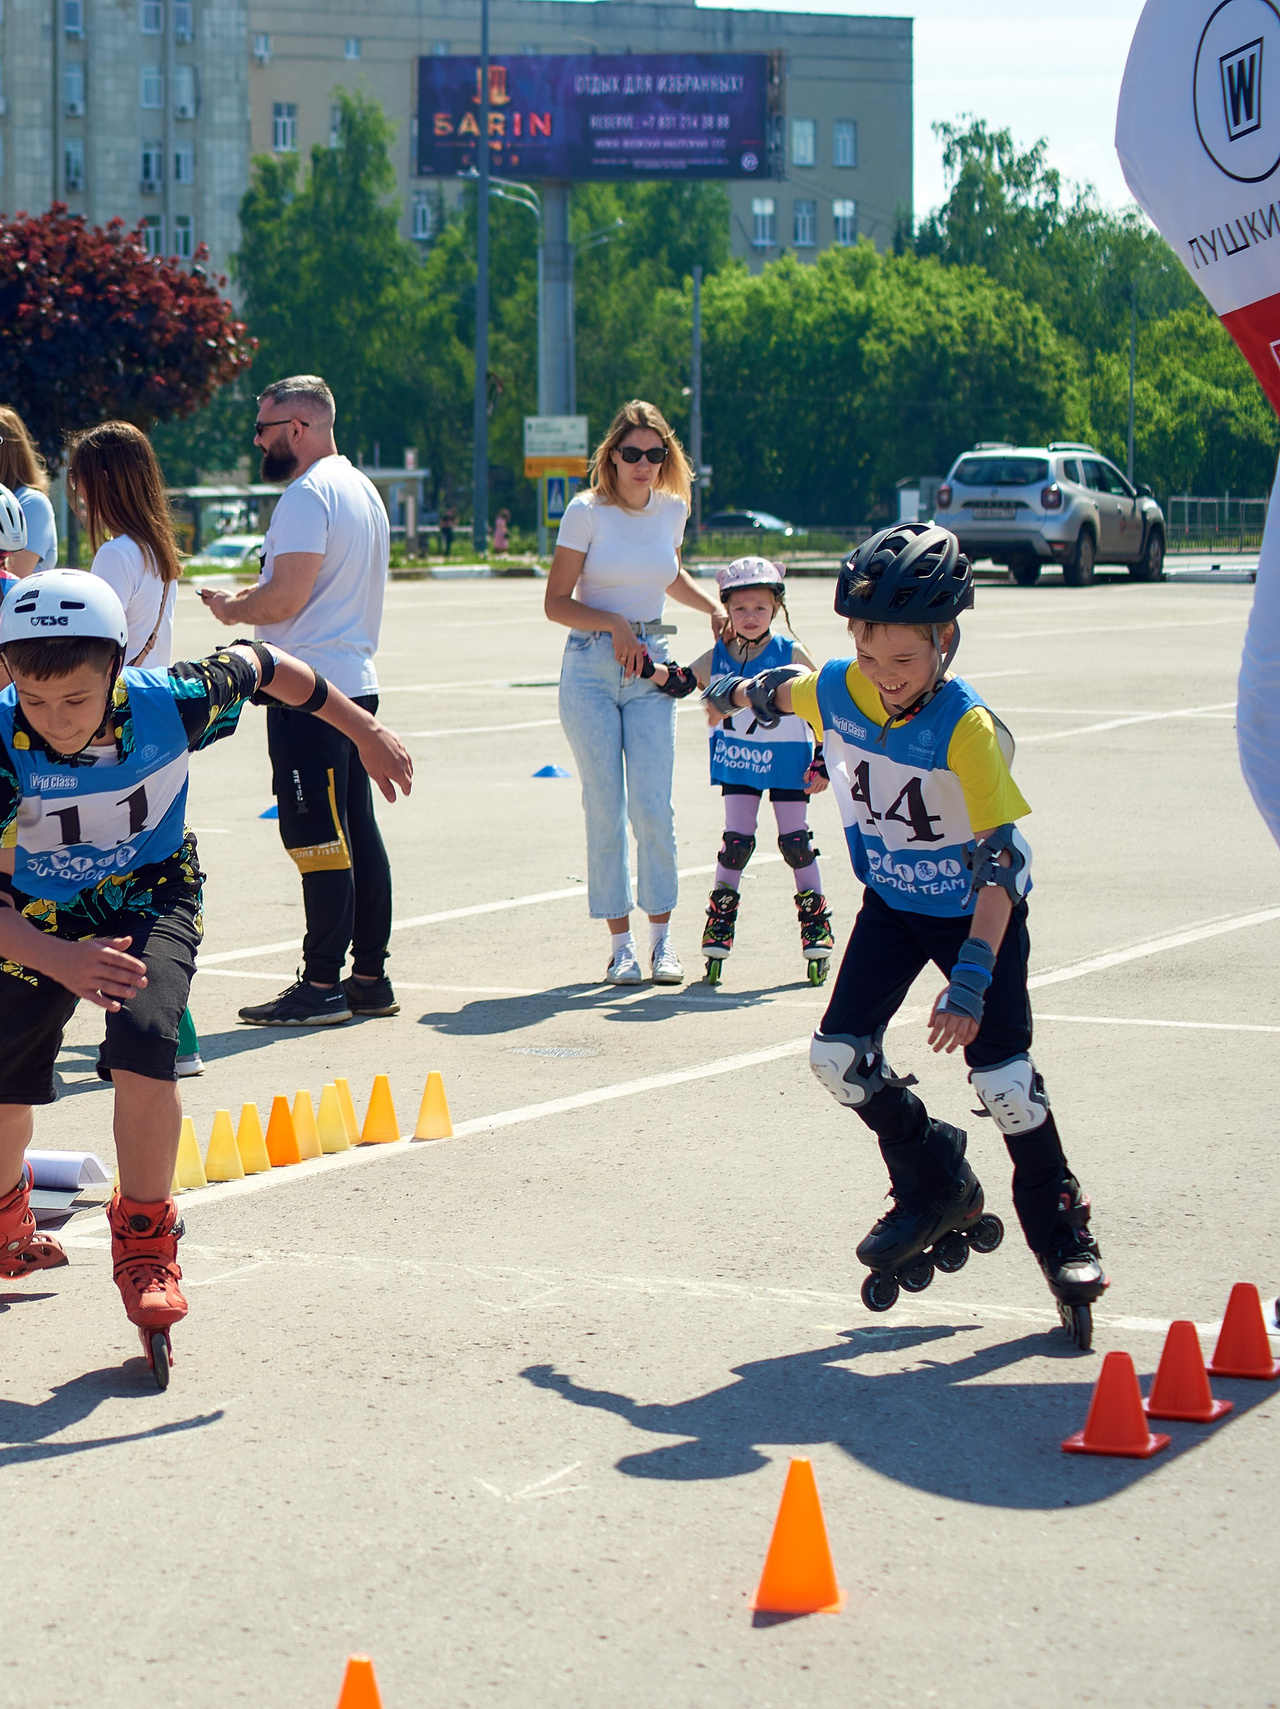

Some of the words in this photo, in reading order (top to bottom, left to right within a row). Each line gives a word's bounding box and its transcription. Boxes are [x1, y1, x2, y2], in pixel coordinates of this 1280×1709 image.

[574, 74, 619, 96] ОТДЫХ
[623, 74, 653, 96] ДЛЯ
[51, 776, 76, 788] Class
[850, 760, 945, 843] 44
[45, 784, 150, 847] 11
[919, 878, 966, 896] TEAM
